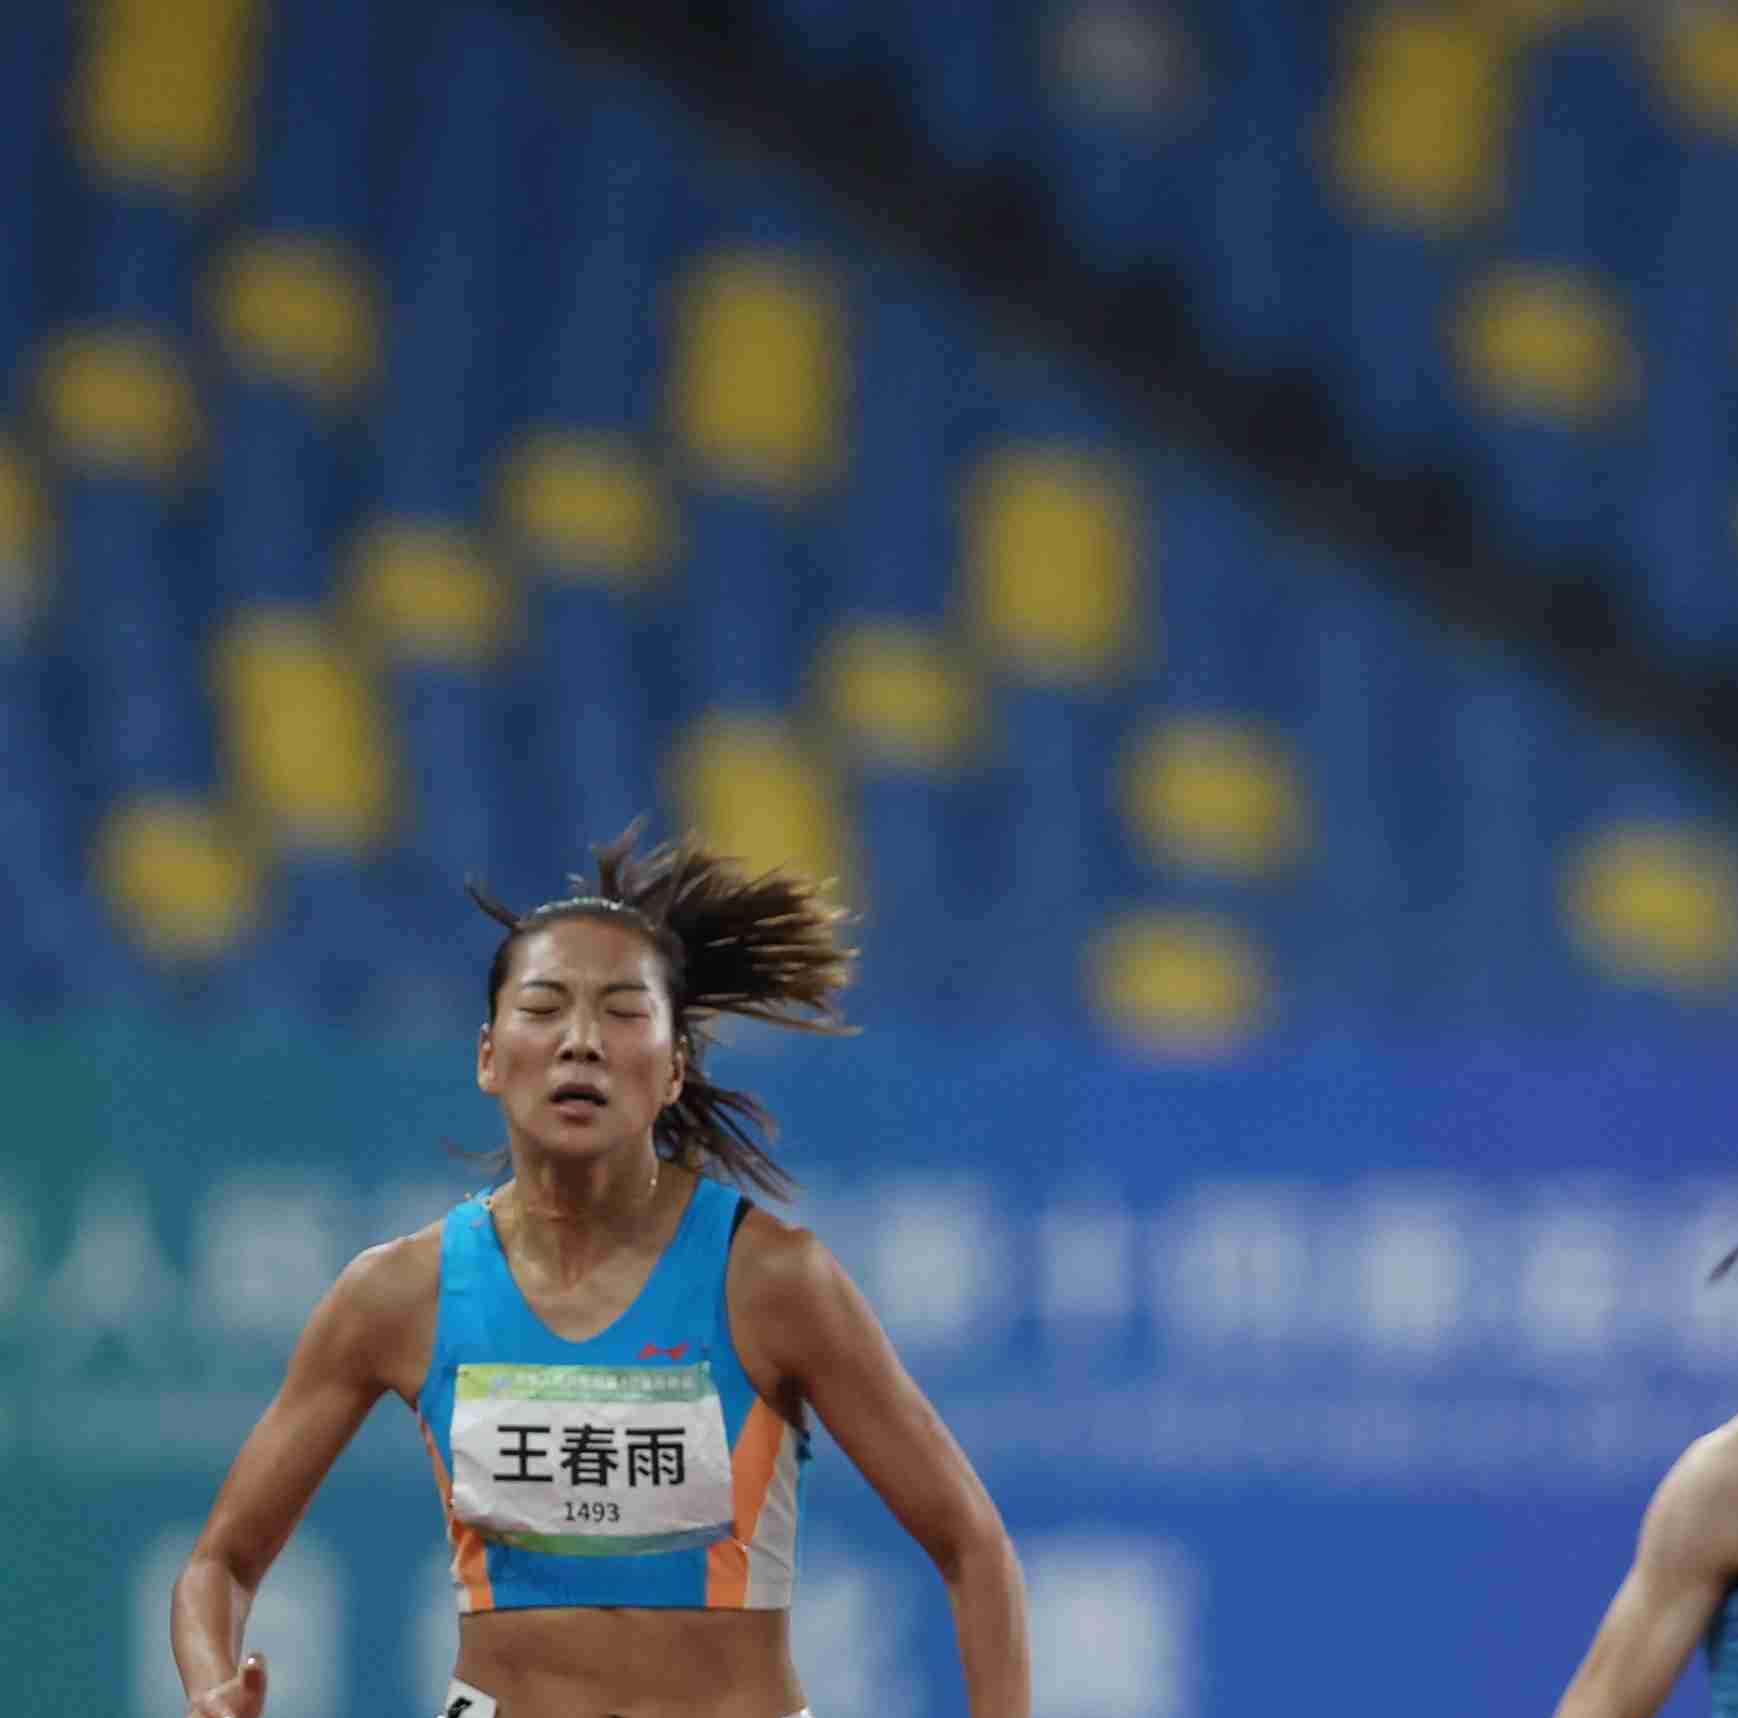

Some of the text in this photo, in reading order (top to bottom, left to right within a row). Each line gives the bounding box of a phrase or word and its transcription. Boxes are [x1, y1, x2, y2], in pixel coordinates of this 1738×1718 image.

[493, 1424, 686, 1489] 王春雨
[563, 1501, 621, 1523] 1493
